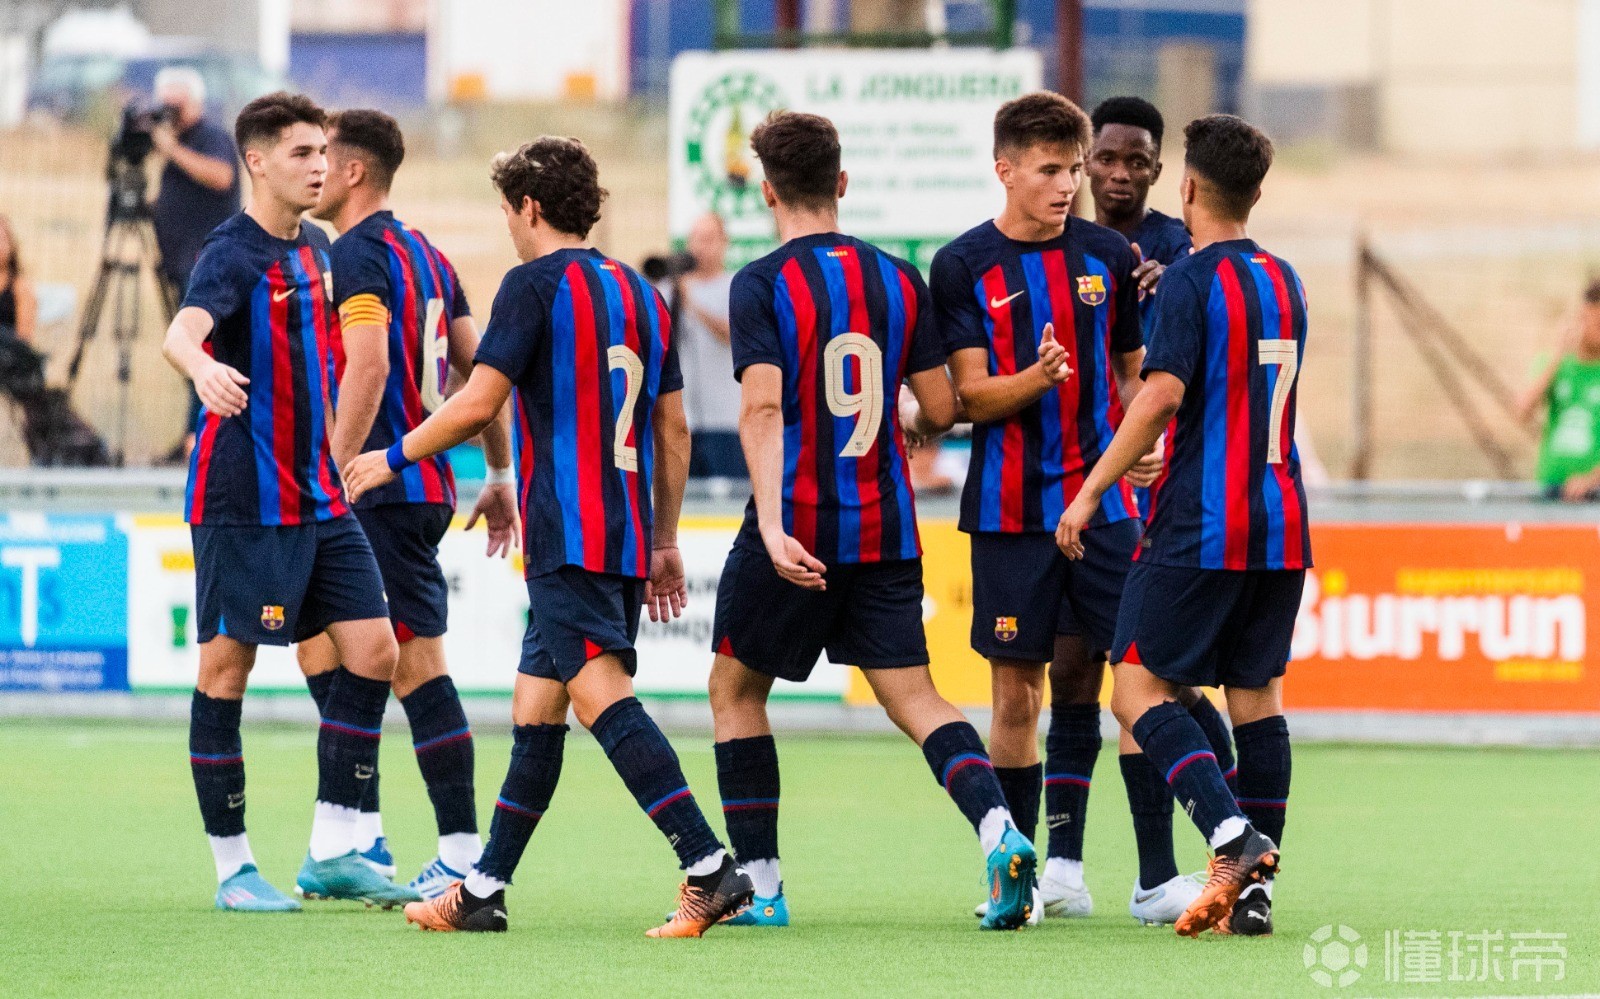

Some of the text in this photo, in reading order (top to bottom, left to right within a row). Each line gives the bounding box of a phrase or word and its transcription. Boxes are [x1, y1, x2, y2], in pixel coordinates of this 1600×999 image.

[806, 73, 842, 101] LA
[607, 344, 645, 473] 2
[824, 332, 884, 457] 9
[1257, 339, 1298, 464] 7
[1290, 569, 1585, 662] Biurrun
